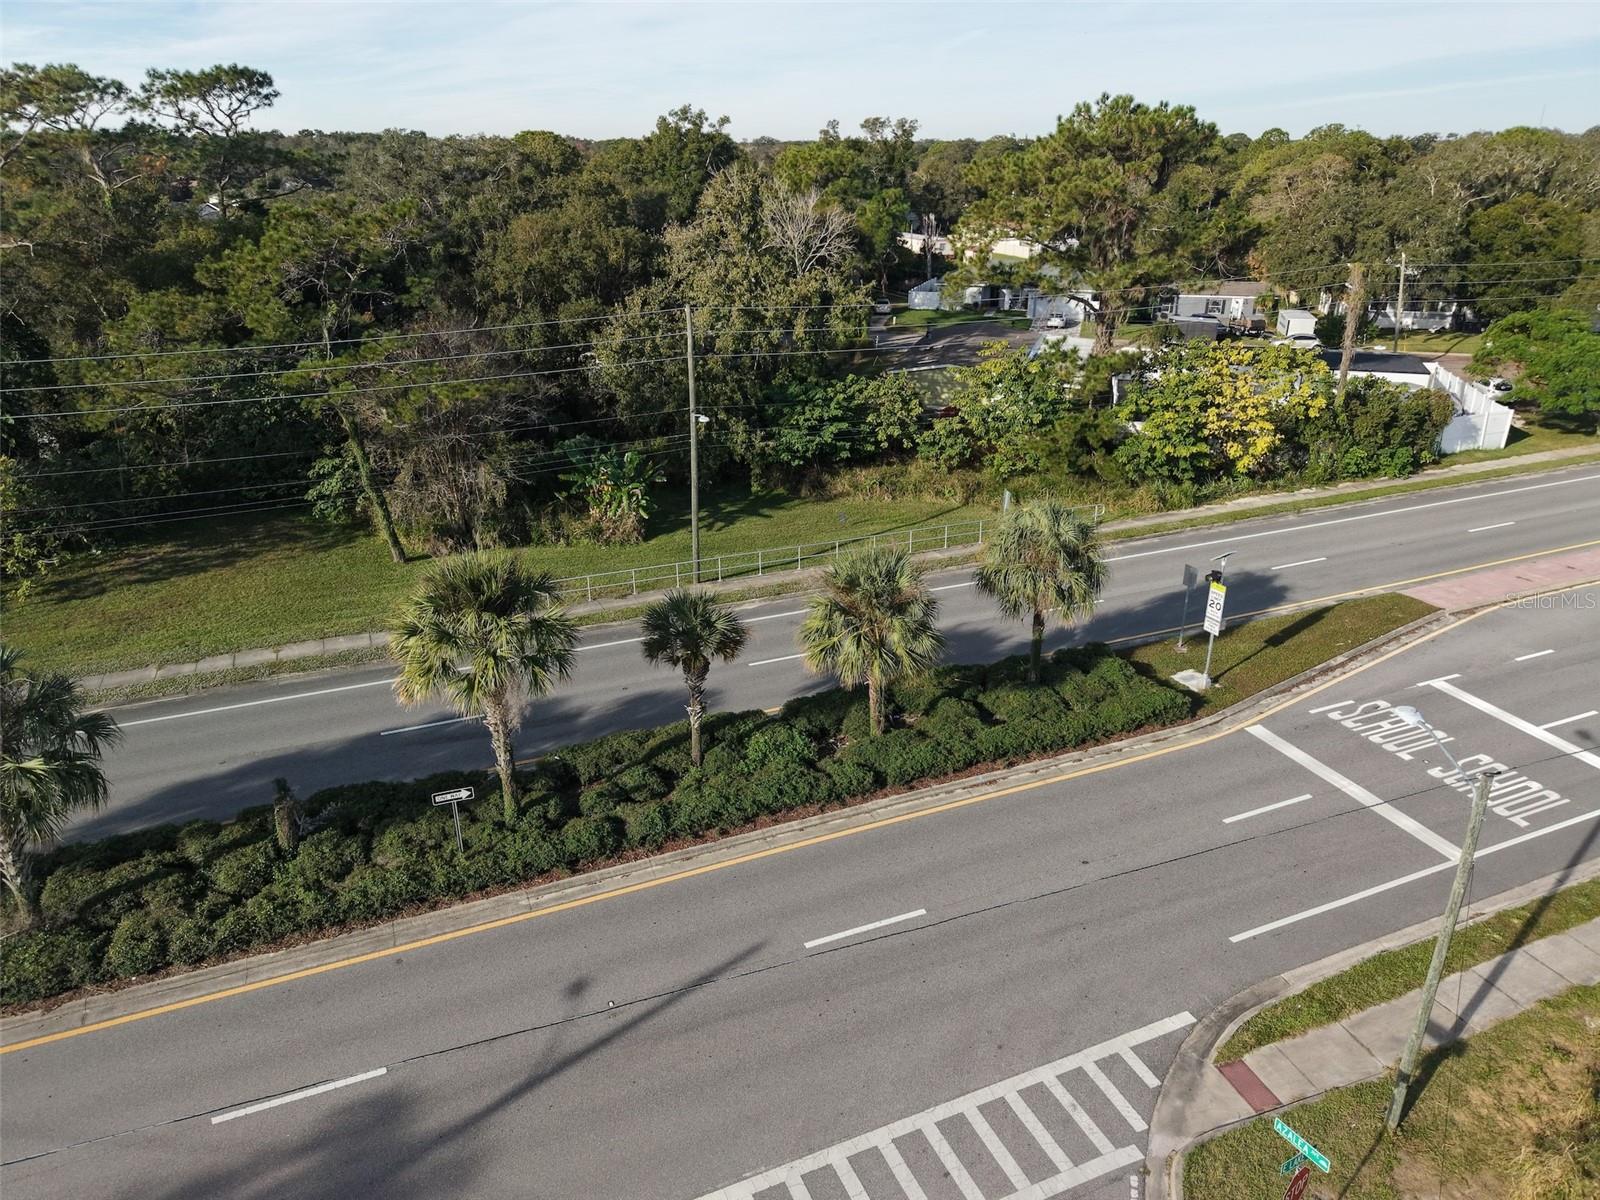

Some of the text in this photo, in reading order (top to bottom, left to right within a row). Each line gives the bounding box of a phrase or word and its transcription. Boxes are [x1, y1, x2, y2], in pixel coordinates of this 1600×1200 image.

[1209, 600, 1222, 611] 20
[1327, 700, 1456, 761] SCHOOL
[1427, 753, 1571, 828] SCHOOL
[1276, 1122, 1309, 1155] AZALEA
